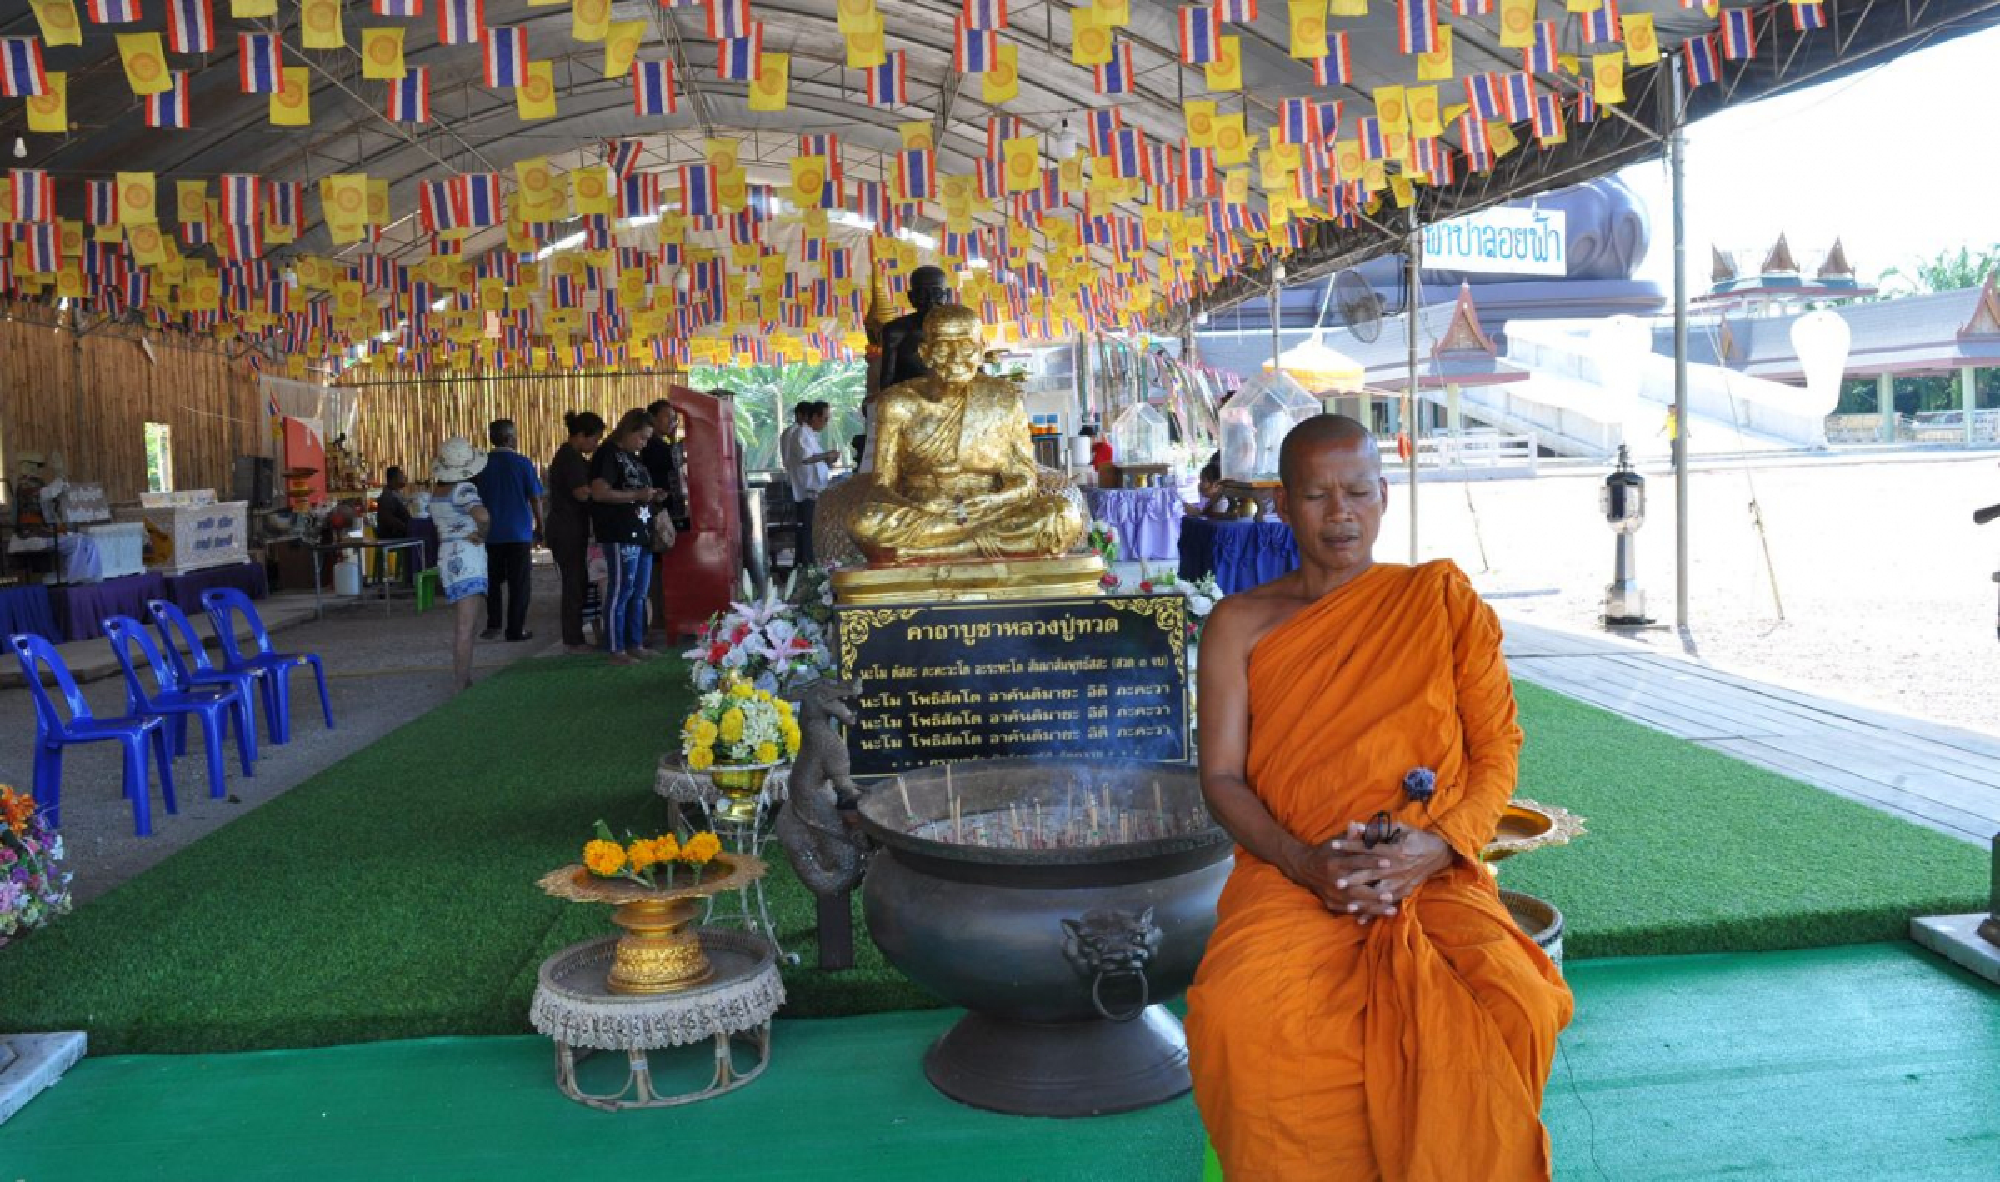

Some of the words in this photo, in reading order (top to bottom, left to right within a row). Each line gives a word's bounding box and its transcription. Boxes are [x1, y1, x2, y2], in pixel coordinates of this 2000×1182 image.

[907, 612, 1119, 646] คาถาบูชาหลวงปู่ทวด
